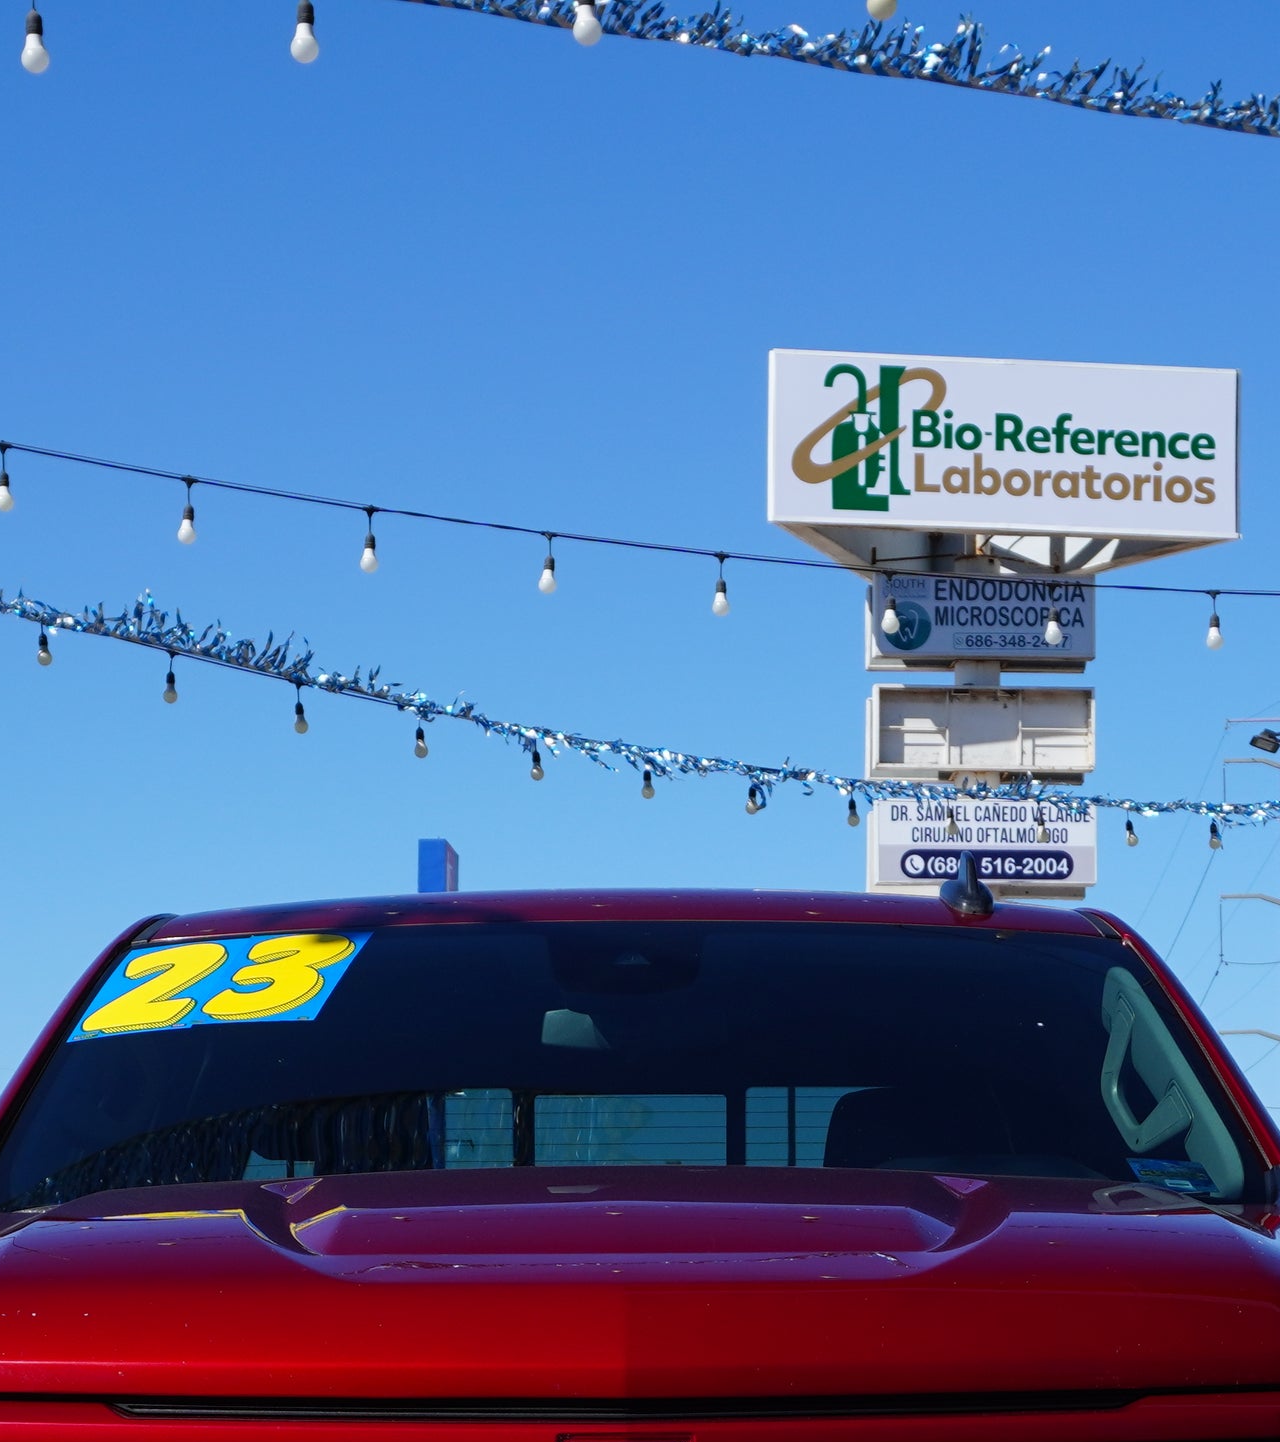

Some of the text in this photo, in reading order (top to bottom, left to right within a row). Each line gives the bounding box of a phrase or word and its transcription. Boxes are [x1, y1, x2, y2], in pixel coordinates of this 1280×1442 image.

[912, 409, 1216, 461] Bio-Reference
[914, 452, 1216, 505] Laboratorios
[934, 579, 1086, 602] ENDODONCIA
[934, 605, 1085, 628] MICROSCOPCA
[965, 634, 1069, 648] 686-348-247
[891, 805, 912, 822] DR.
[916, 804, 970, 822] SAMEL
[974, 803, 1027, 822] CAÑEDO
[911, 822, 1069, 844] CIRUJANO OFTALMÓGO
[981, 857, 1069, 875] 516-2004
[82, 934, 356, 1034] 23
